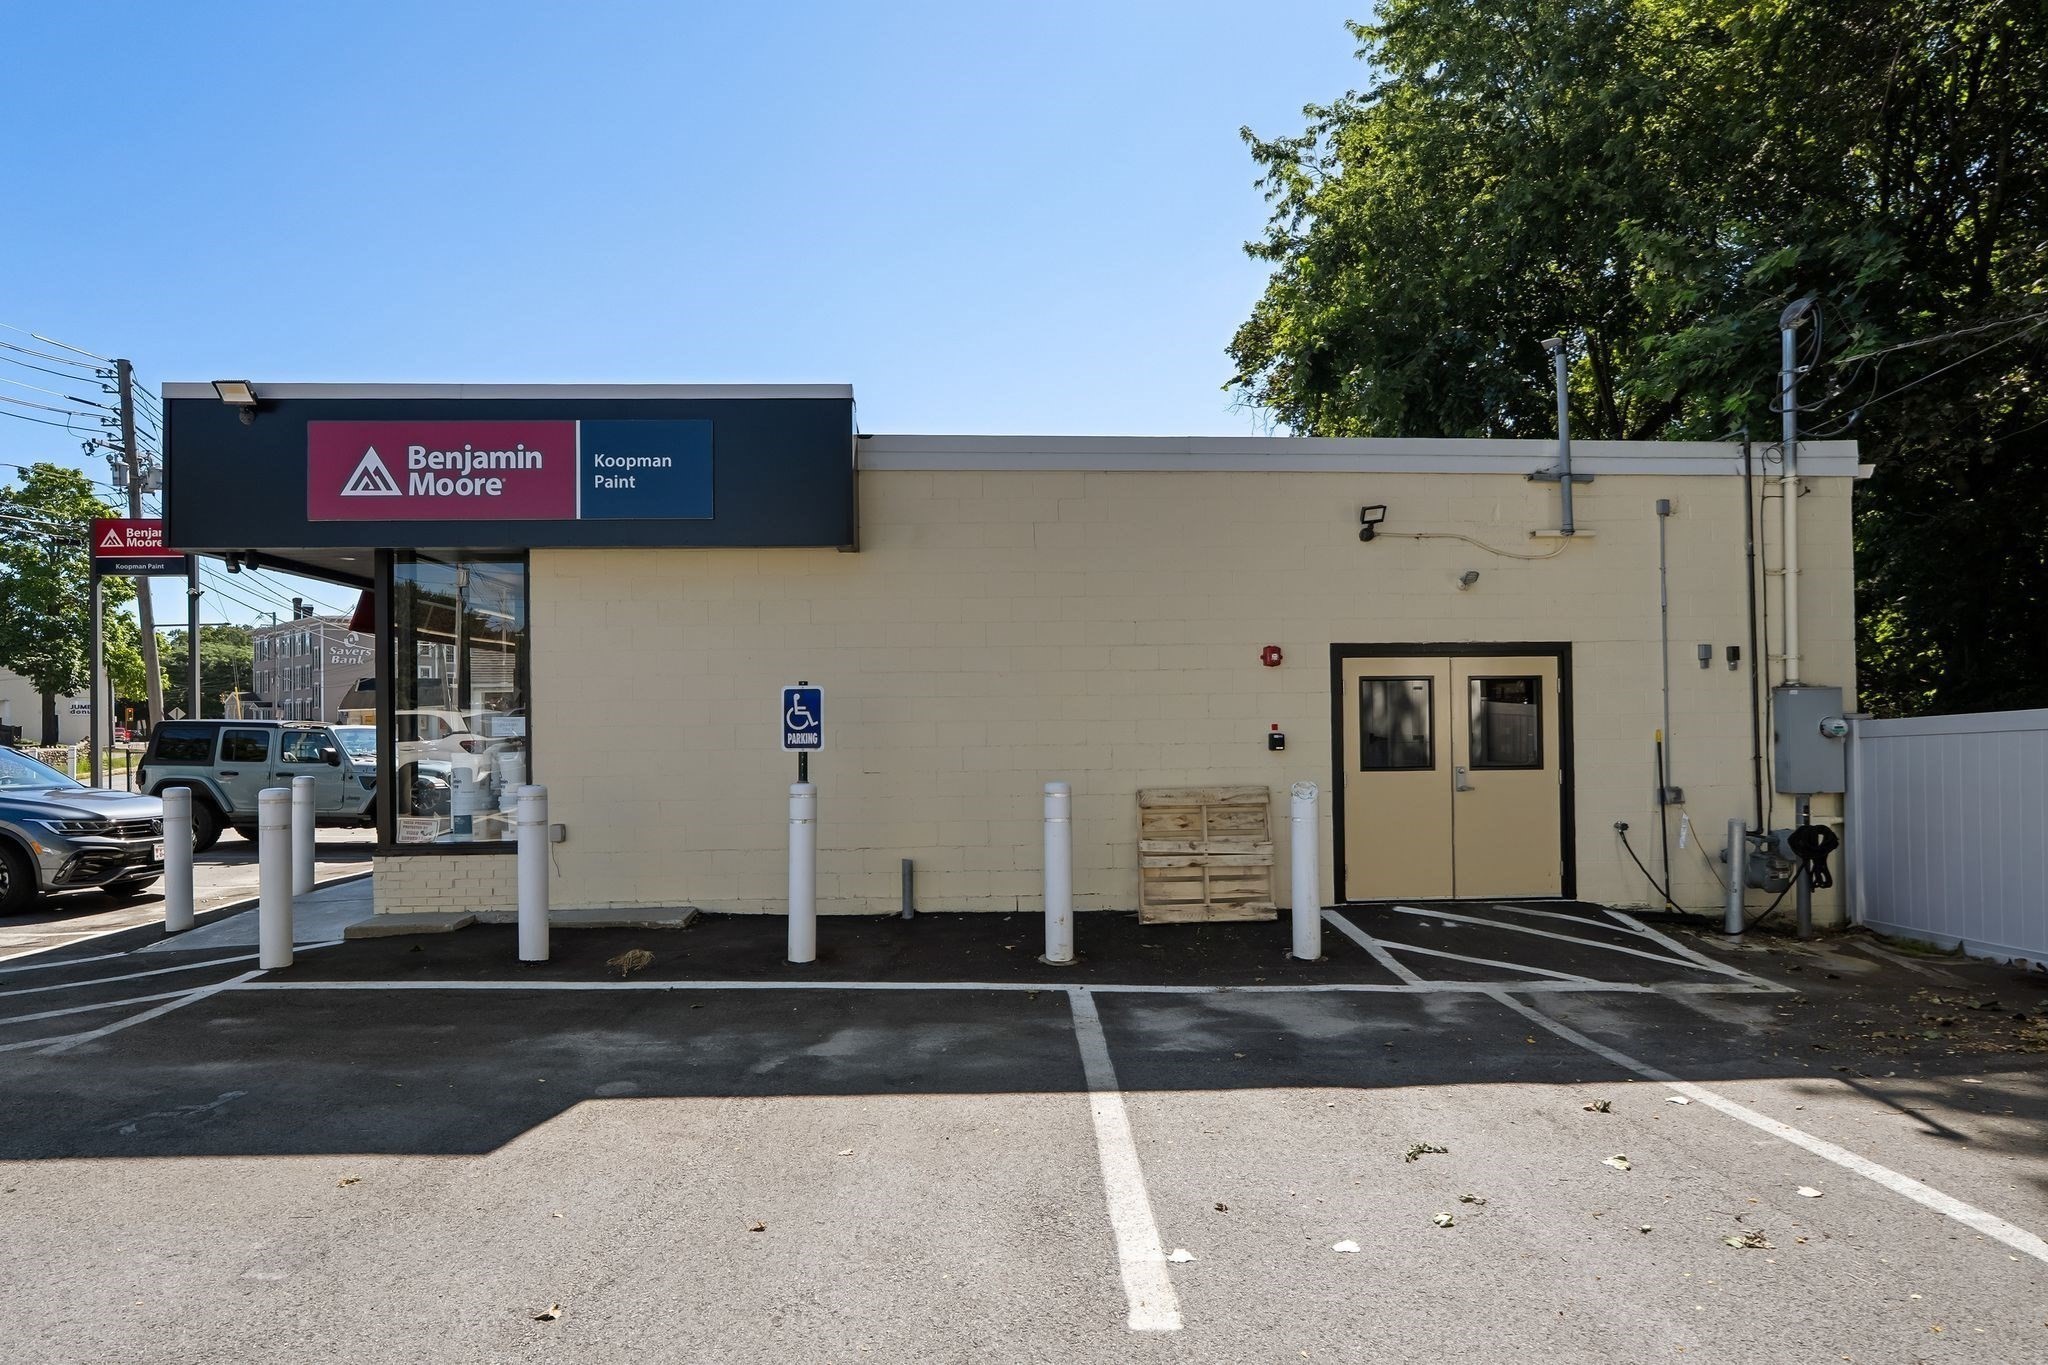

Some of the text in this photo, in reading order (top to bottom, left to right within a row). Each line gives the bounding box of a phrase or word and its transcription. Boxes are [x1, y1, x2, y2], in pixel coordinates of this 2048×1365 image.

[408, 444, 542, 475] Benjamin
[594, 453, 672, 471] Koopman
[408, 472, 503, 496] Moore
[594, 474, 636, 489] Paint
[126, 538, 162, 547] Moore
[115, 563, 147, 571] Koopman
[329, 646, 371, 656] Savers
[331, 655, 364, 664] Bank
[787, 732, 818, 745] PARKING
